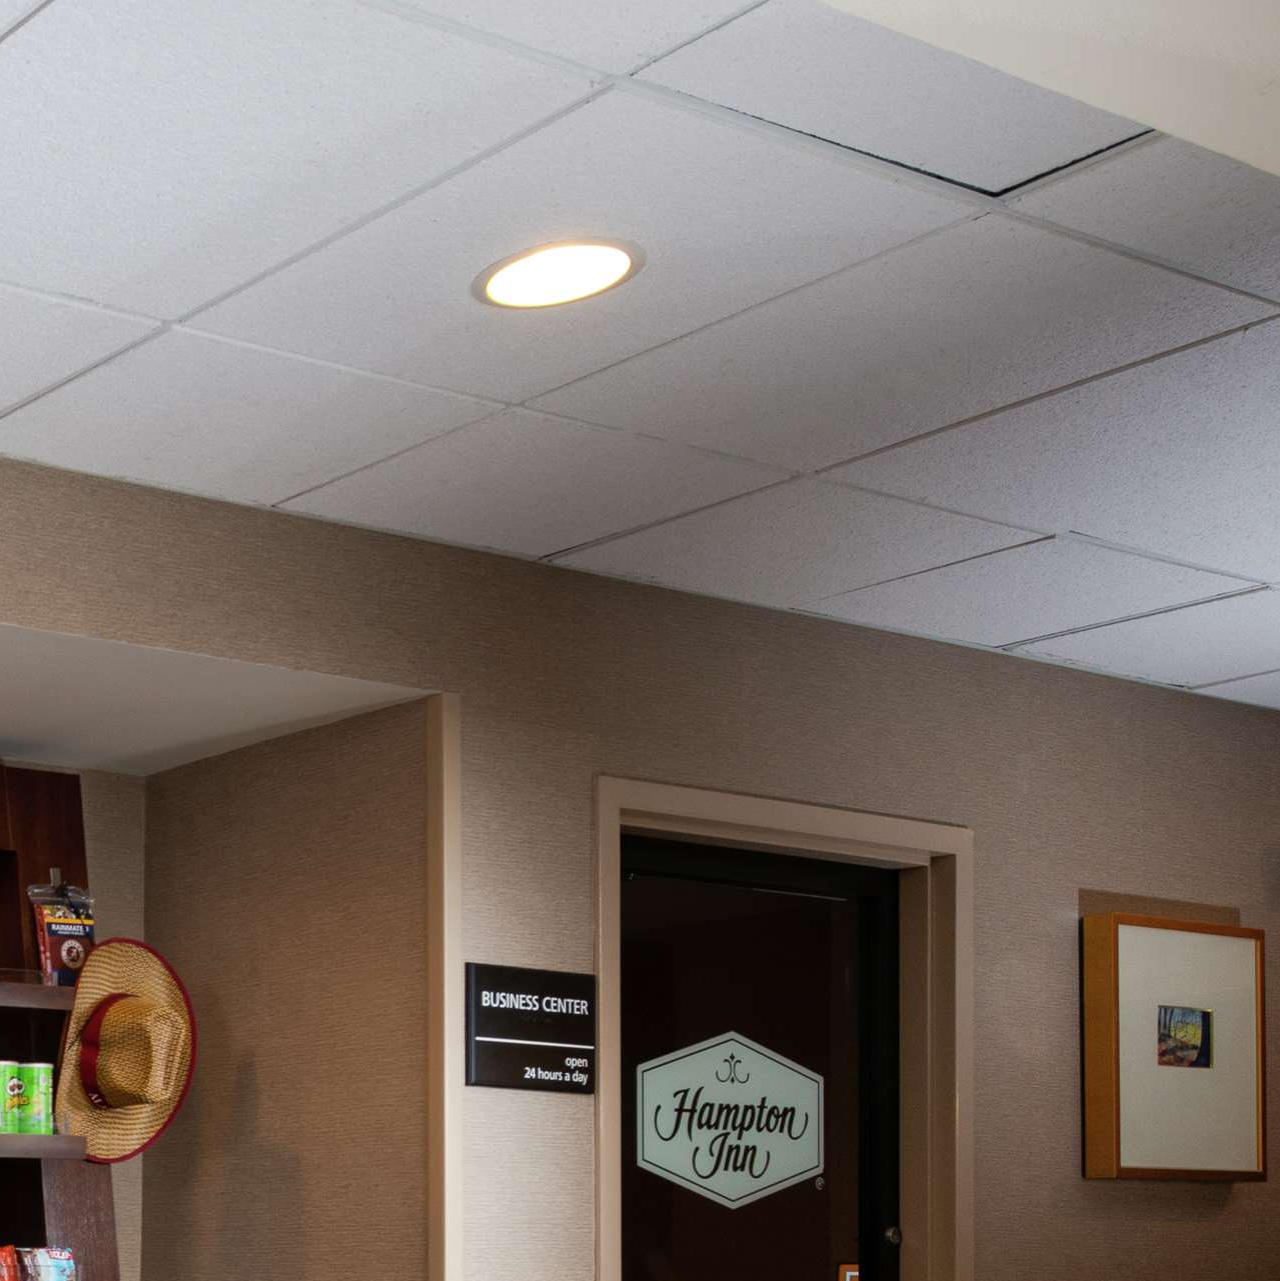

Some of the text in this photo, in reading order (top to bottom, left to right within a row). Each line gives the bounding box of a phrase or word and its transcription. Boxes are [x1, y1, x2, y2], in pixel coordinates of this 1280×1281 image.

[480, 990, 589, 1015] BUSINESS CENTER
[564, 1056, 589, 1069] open
[523, 1066, 589, 1085] 24 hours a day
[653, 1086, 809, 1143] Hampton
[692, 1131, 771, 1179] Inn
